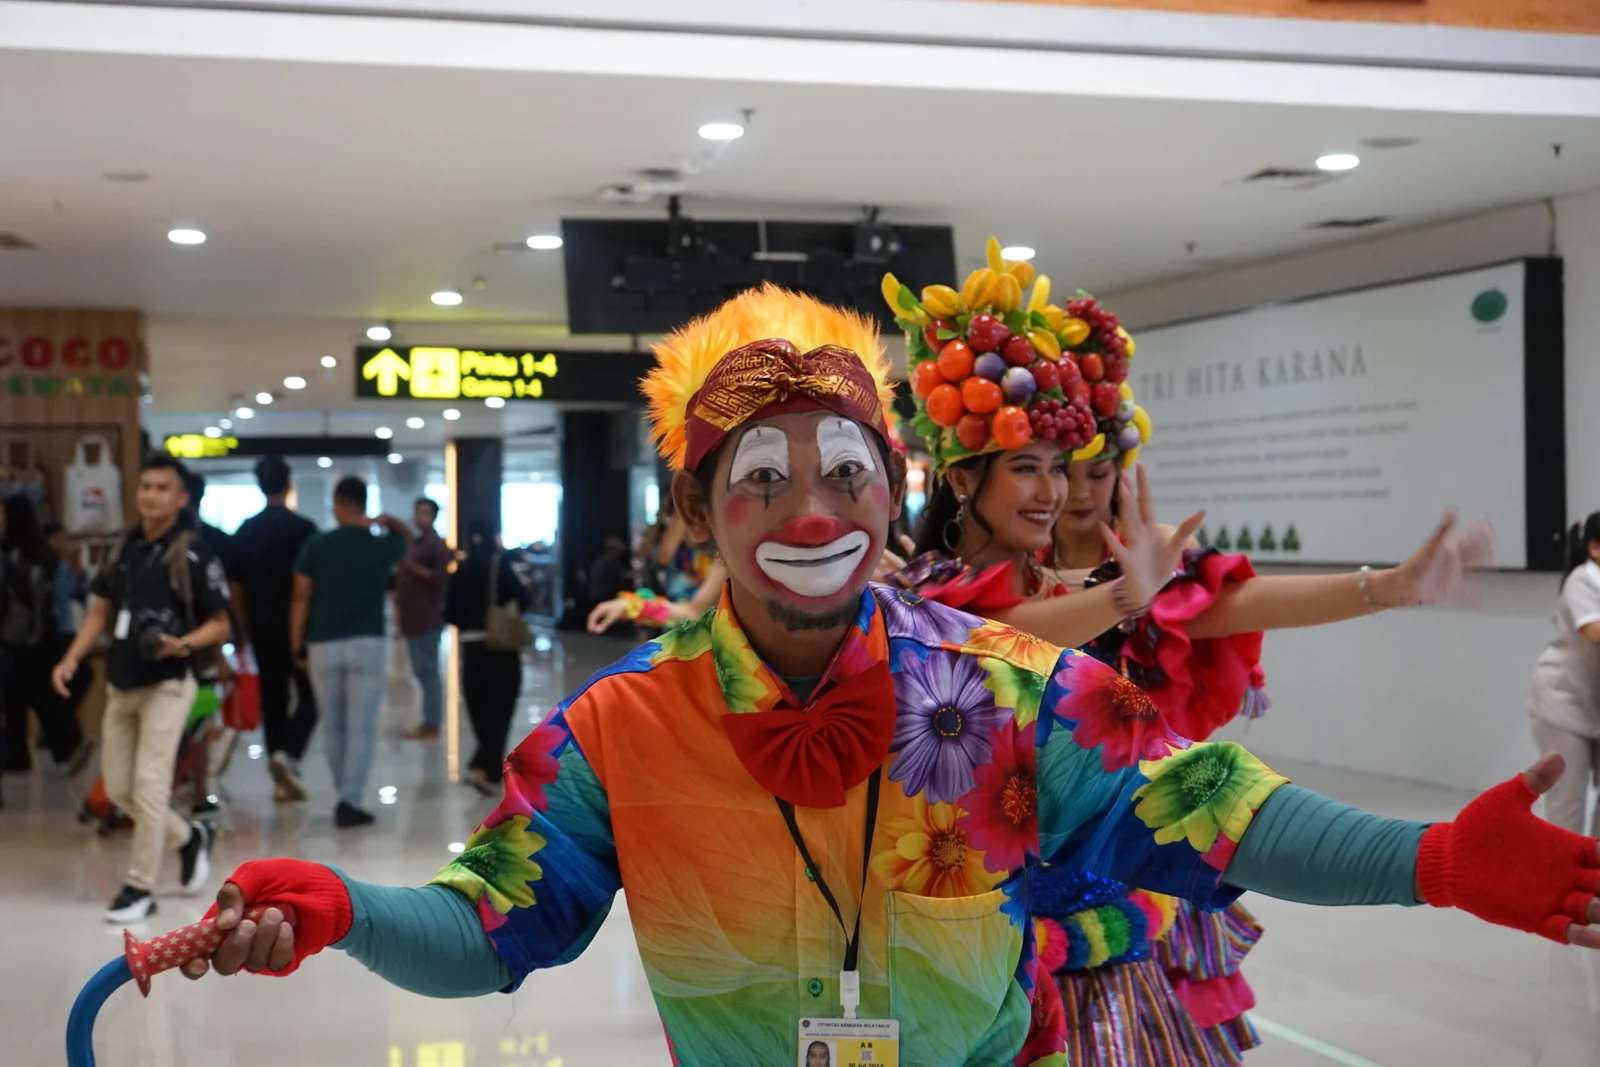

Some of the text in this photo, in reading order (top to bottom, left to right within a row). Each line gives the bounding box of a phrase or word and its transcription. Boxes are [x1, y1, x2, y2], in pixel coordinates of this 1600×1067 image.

[0, 375, 130, 397] EWATA
[1140, 344, 1369, 402] TRI HITA KARANA
